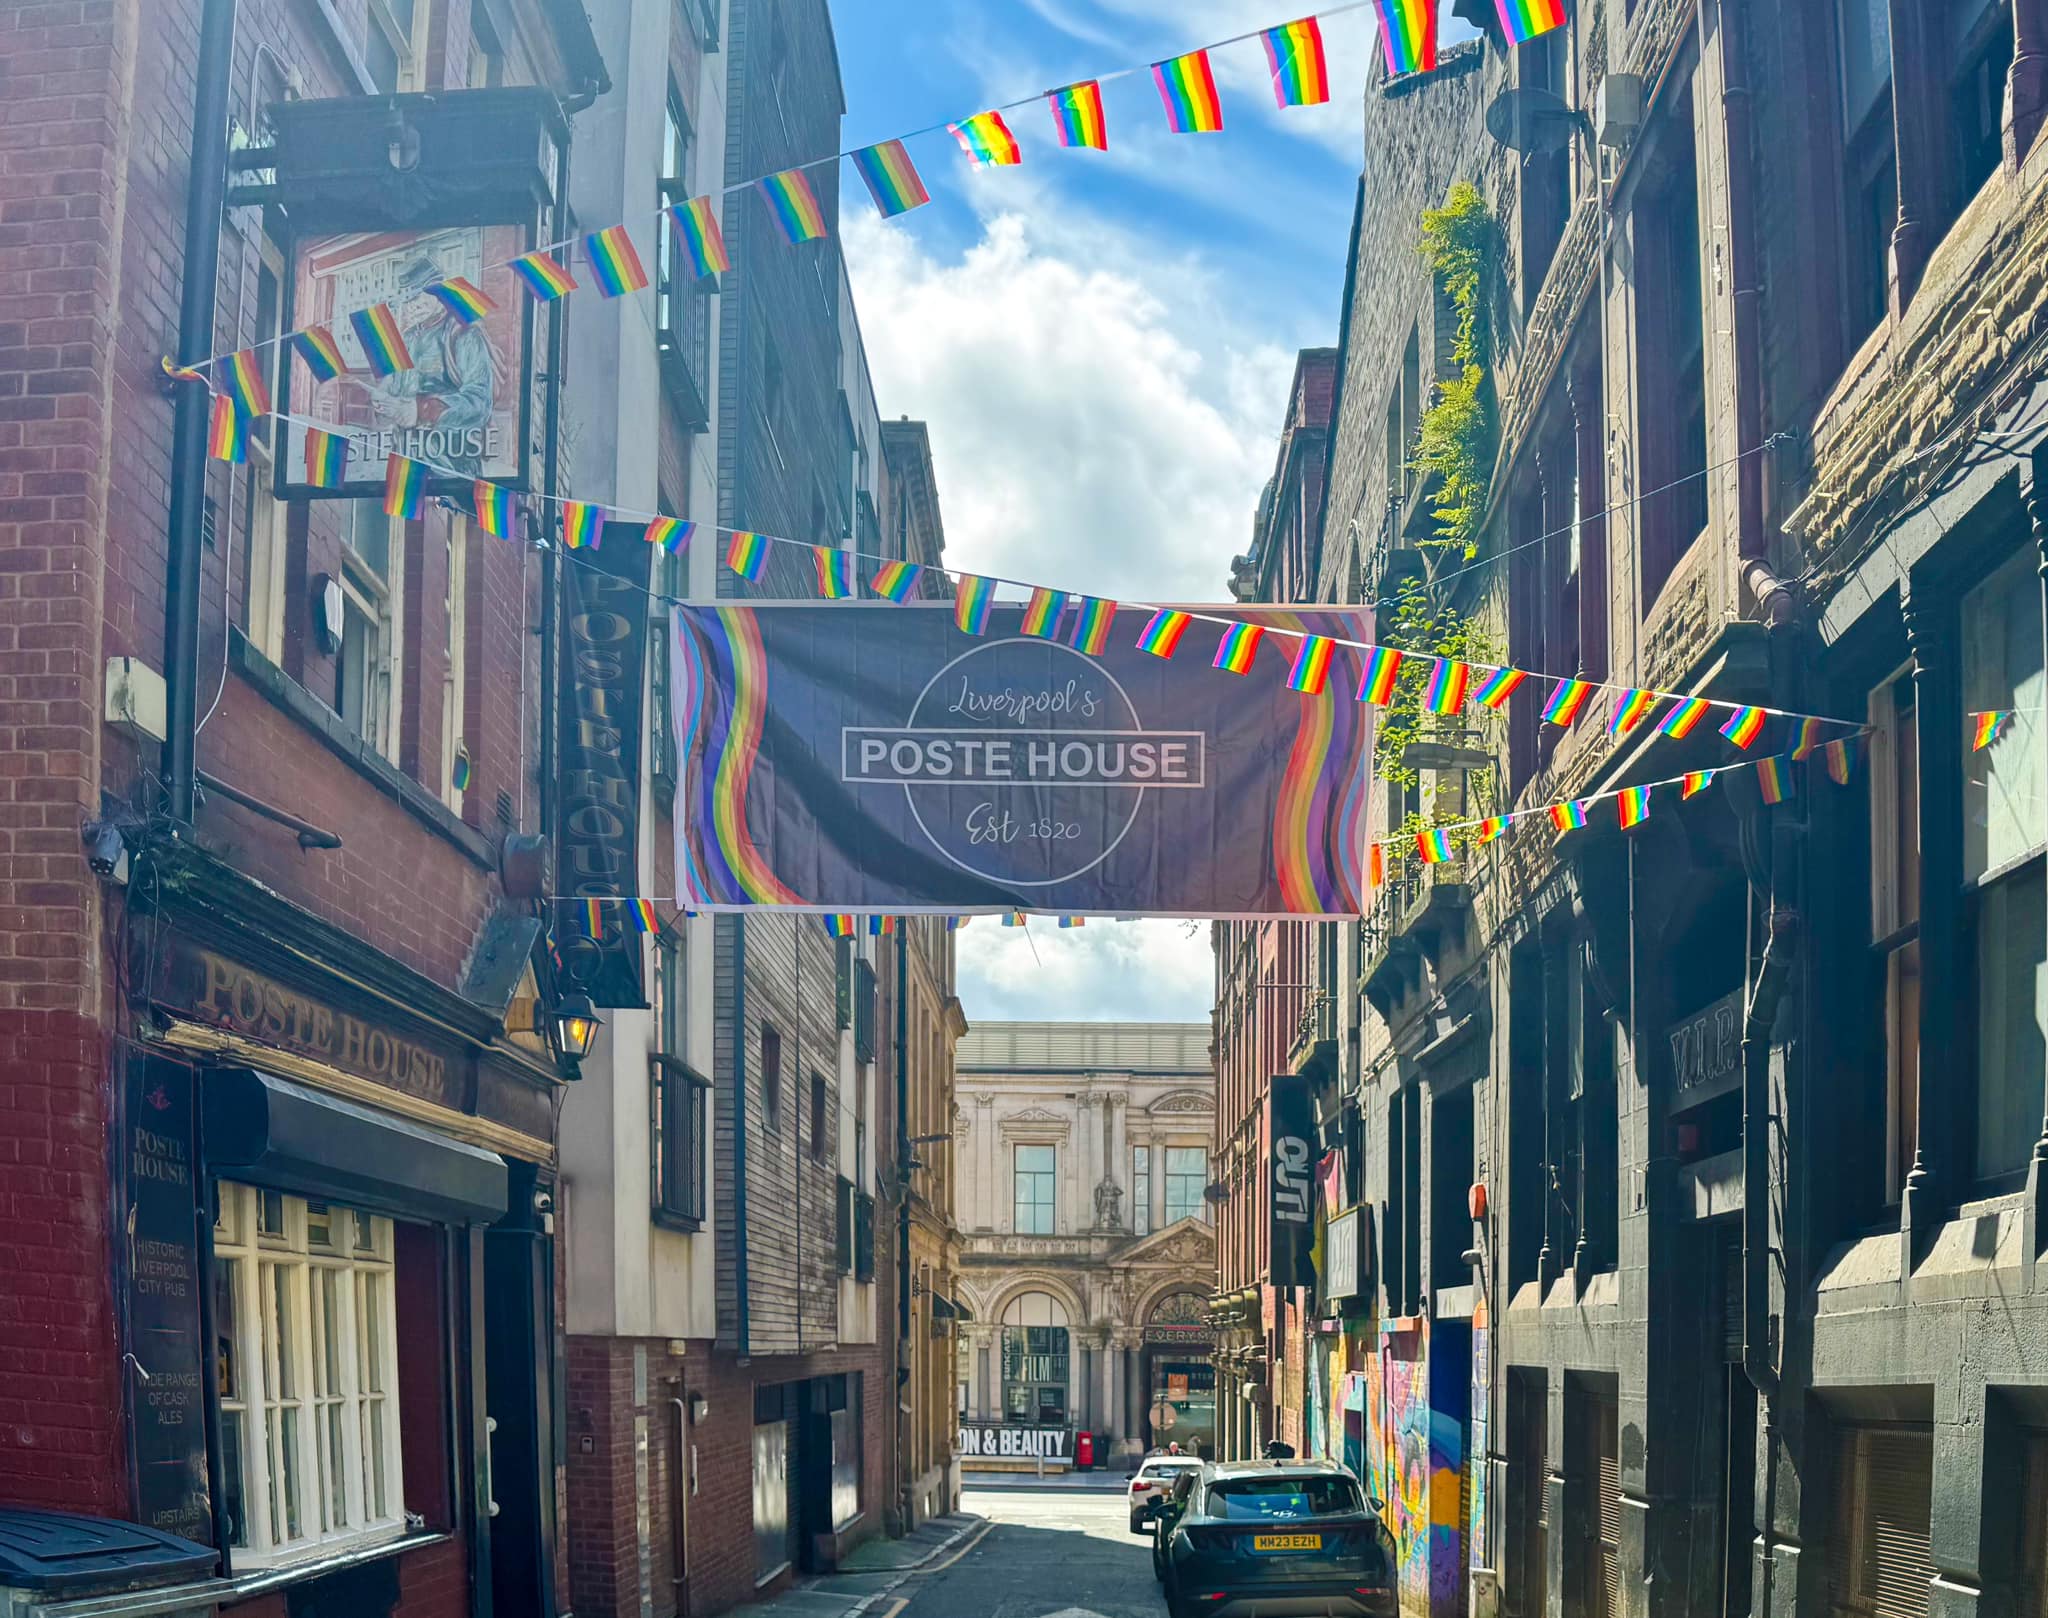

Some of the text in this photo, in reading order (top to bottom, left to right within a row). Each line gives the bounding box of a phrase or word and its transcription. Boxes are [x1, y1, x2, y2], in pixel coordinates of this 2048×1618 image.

[403, 427, 500, 458] HOUSE
[948, 675, 1101, 724] Liverpool's
[860, 739, 1188, 778] POSTE HOUSE
[965, 802, 1081, 845] Est 1820
[198, 953, 446, 1097] POSTE HOUSE
[133, 1127, 188, 1185] POSTE HOUSE
[136, 1239, 185, 1260] HISTORIC
[133, 1258, 190, 1279] LIVERPOOL
[138, 1278, 186, 1297] CITY PUB
[136, 1373, 199, 1387] WIDE RANGE
[1022, 1355, 1050, 1382] FILM
[148, 1392, 190, 1406] OF CASK
[158, 1410, 184, 1425] ALES
[983, 1429, 998, 1455] &
[1000, 1429, 1065, 1456] BEAUTY
[152, 1506, 201, 1526] UPSTAIRS
[1293, 1536, 1316, 1547] EZH
